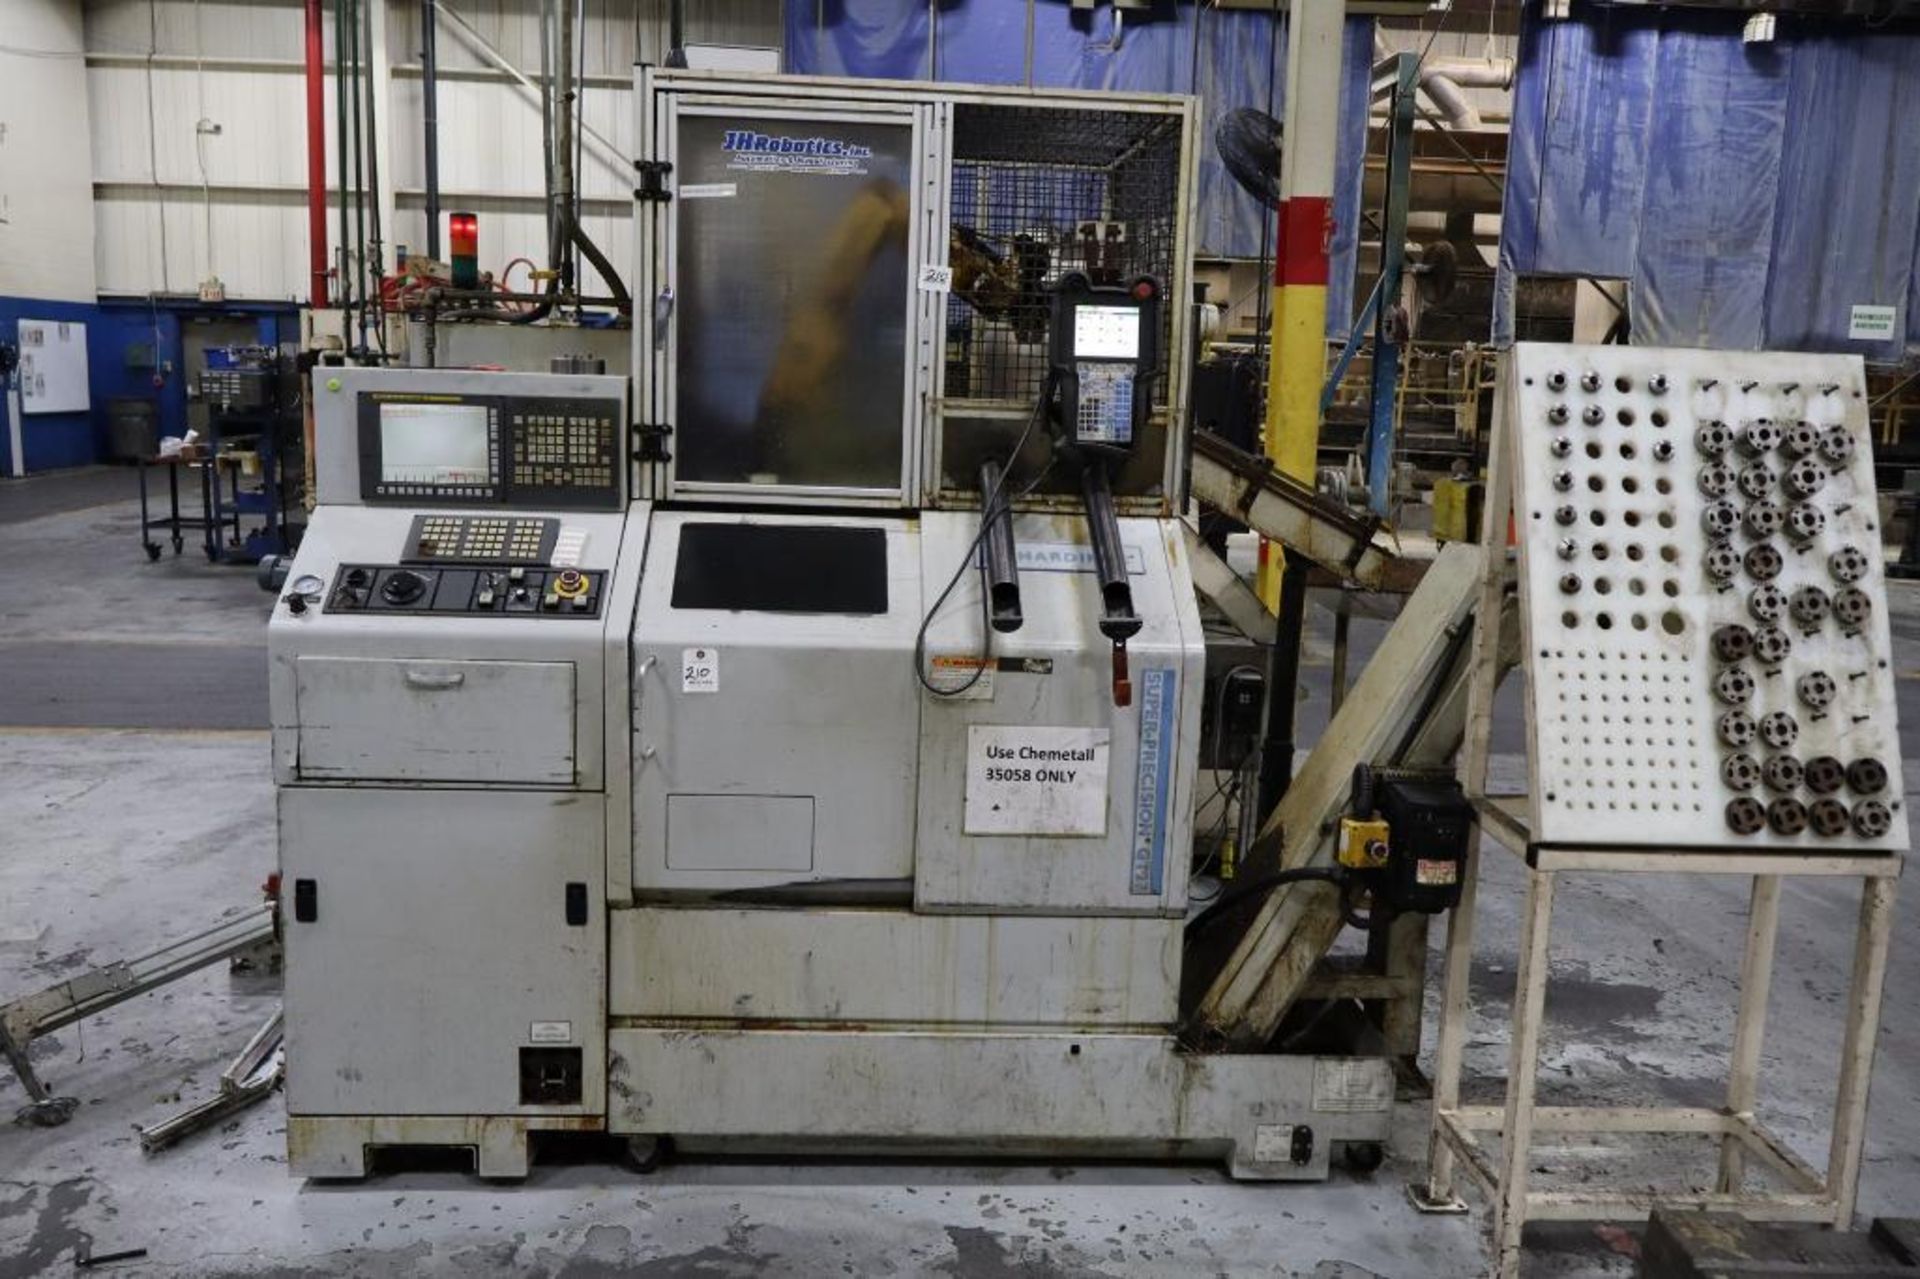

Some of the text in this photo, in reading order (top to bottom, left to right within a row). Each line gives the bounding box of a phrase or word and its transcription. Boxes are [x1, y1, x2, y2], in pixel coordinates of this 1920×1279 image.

[1017, 550, 1096, 564] HARDIN
[685, 666, 710, 680] 210
[986, 745, 1095, 761] Use Chemetall
[986, 767, 1076, 783] 35058 ONLY
